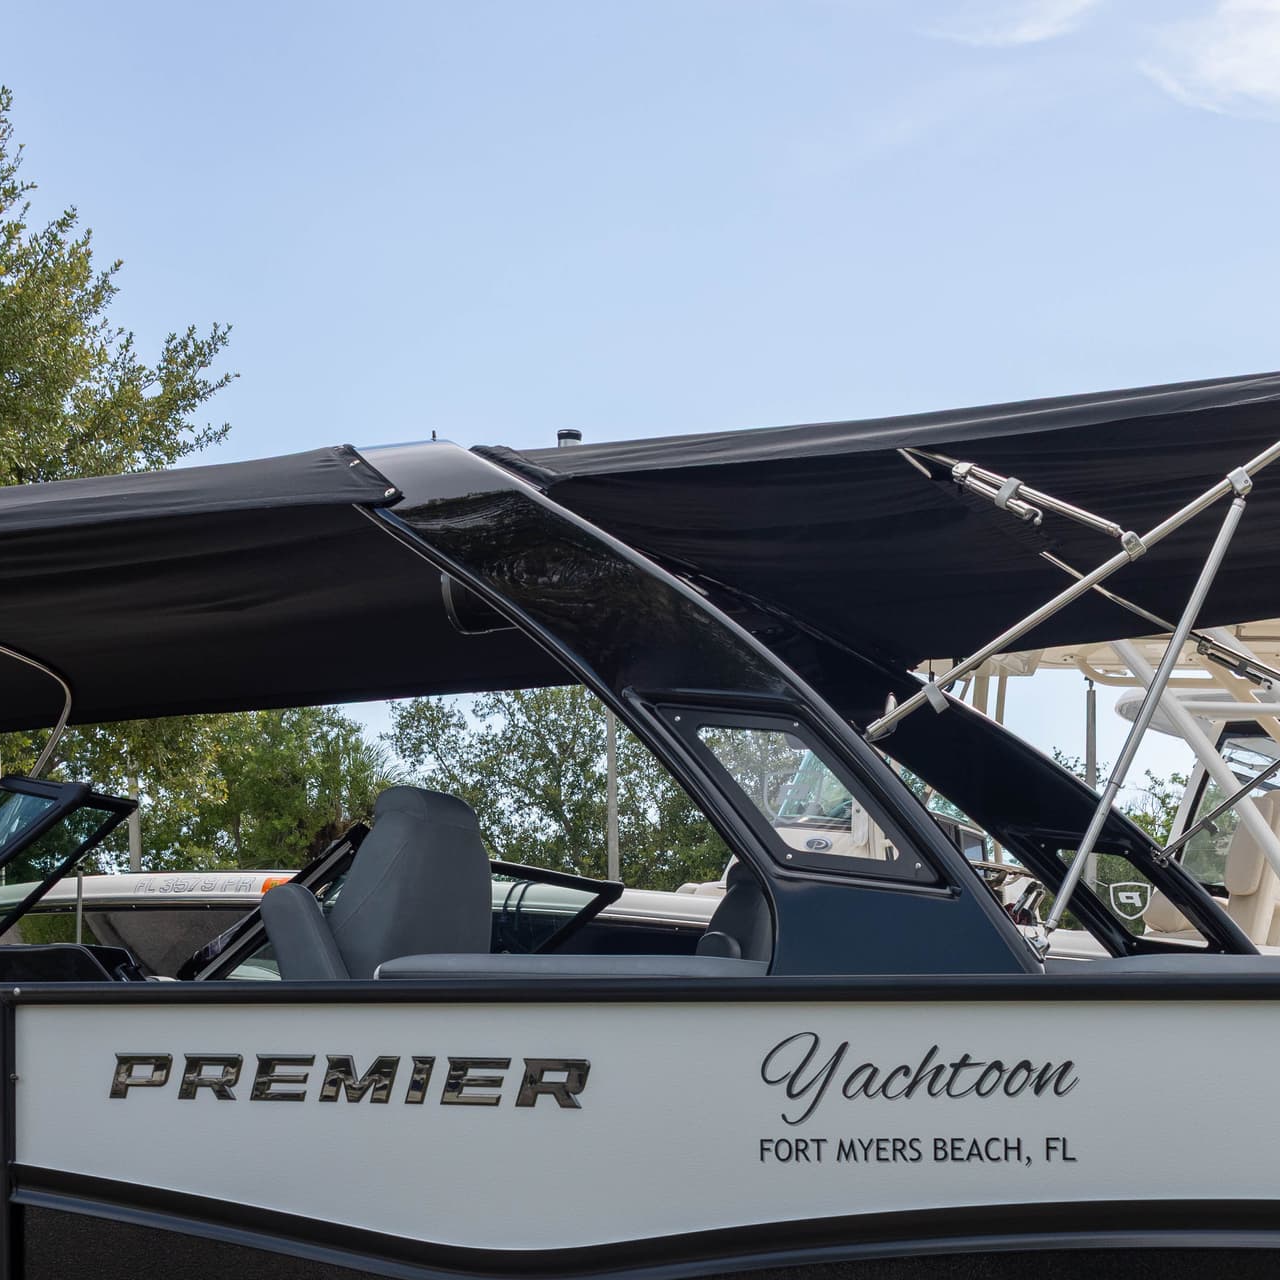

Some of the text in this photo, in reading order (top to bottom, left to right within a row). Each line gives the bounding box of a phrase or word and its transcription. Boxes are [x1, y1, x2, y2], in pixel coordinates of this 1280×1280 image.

[134, 878, 156, 893] FL
[109, 1052, 591, 1109] PREMIER
[760, 1031, 1080, 1126] Yachtoon
[759, 1137, 1078, 1168] FORT MYERS BEACH, FL
